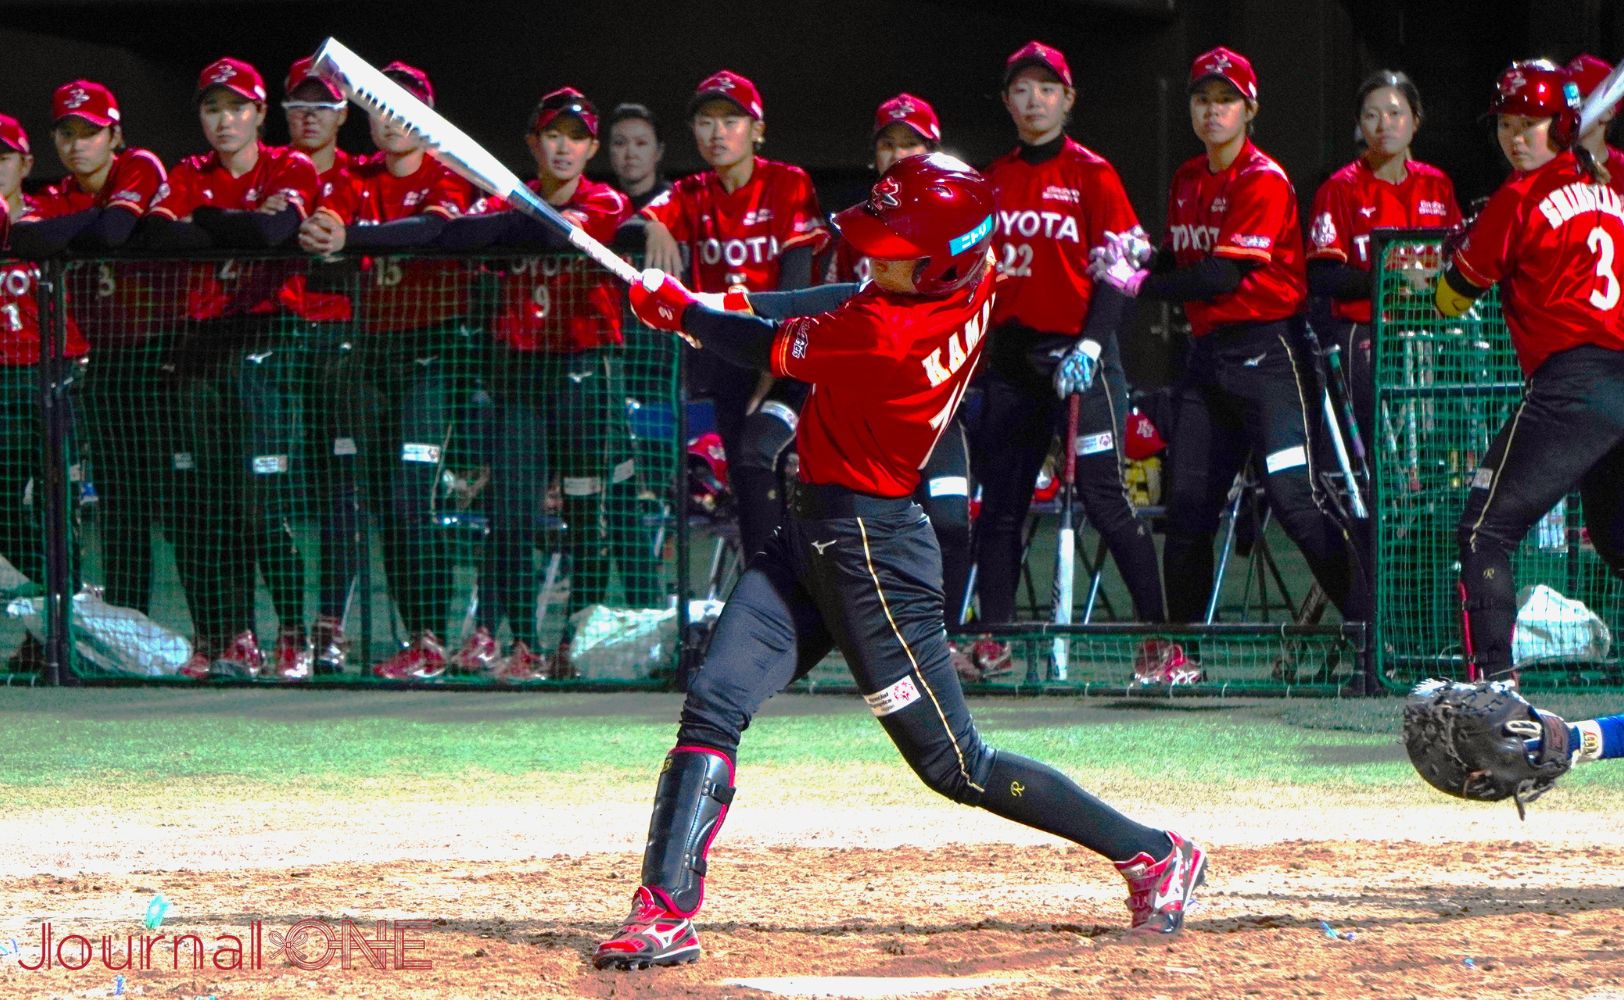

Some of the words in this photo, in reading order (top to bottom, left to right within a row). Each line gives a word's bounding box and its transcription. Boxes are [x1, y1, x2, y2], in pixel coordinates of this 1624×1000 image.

[995, 209, 1080, 243] YOTA
[374, 256, 402, 286] 15
[996, 242, 1034, 278] 22
[1587, 226, 1621, 311] 3
[534, 284, 550, 318] 9
